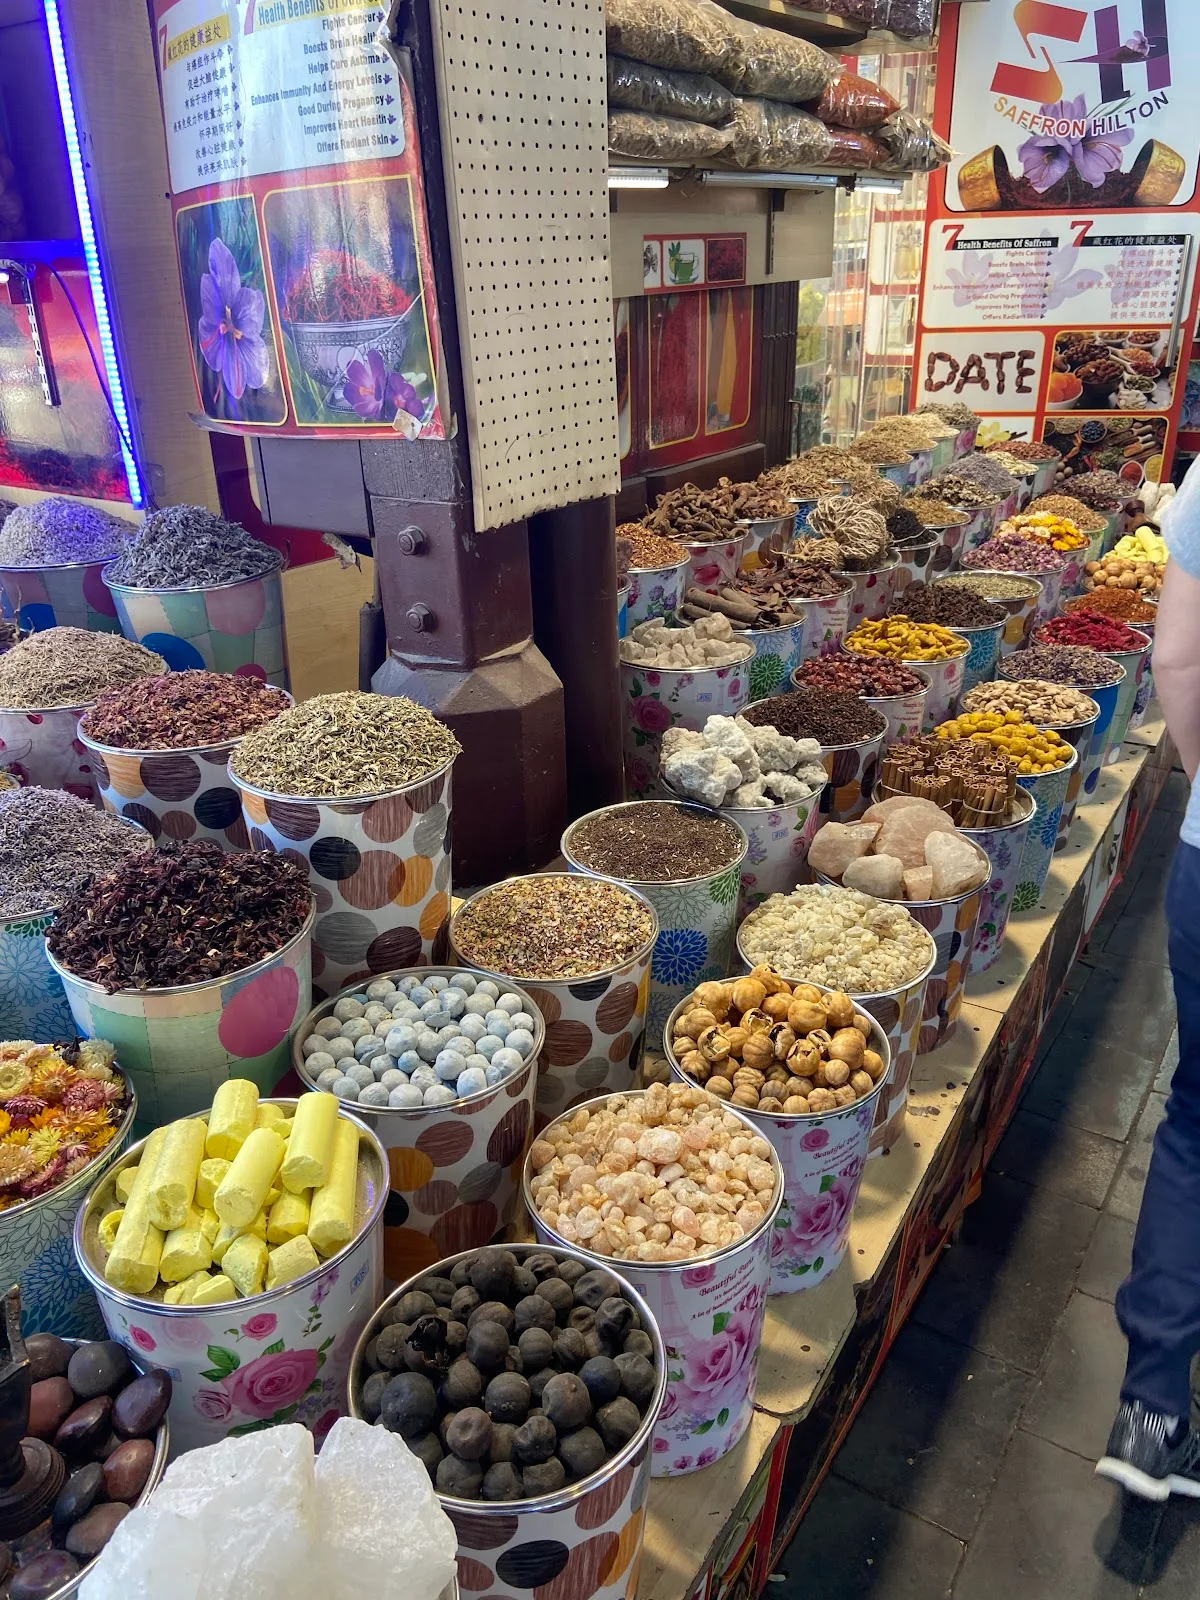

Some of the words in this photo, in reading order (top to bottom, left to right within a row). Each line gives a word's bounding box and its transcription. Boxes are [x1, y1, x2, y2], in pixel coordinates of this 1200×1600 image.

[259, 2, 285, 25] Health
[322, 17, 345, 30] Fights
[347, 13, 376, 26] Cancer
[159, 24, 168, 71] 7
[304, 42, 328, 54] Boosts
[330, 36, 350, 49] Brain
[352, 31, 379, 45] Health
[308, 62, 329, 75] Helps
[331, 59, 348, 71] Cure
[351, 53, 380, 67] Asthma
[251, 92, 280, 106] Enhances
[281, 85, 312, 100] Immunity
[313, 82, 327, 94] And
[329, 78, 355, 92] Energy
[357, 73, 383, 85] Levels
[298, 105, 316, 116] Good
[317, 100, 342, 113] During
[343, 94, 384, 110] Pregnancy
[993, 96, 1086, 138] SAFFRON
[1091, 91, 1169, 137] HILTON
[304, 122, 336, 136] Improves
[338, 118, 359, 130] Heart
[361, 114, 387, 126] Health
[317, 141, 339, 153] Offers
[341, 137, 370, 150] Radiant
[372, 134, 389, 145] Skin
[941, 225, 964, 251] 7
[958, 241, 981, 249] Health
[983, 240, 1012, 248] Benefits
[1014, 239, 1023, 247] Of
[1025, 239, 1052, 247] Saffron
[1070, 220, 1093, 248] 7
[1093, 235, 1177, 246] 藏红花的健康益处
[925, 350, 1035, 394] DATE
[813, 1140, 846, 1160] Beautiful
[699, 1268, 739, 1297] Beautiful
